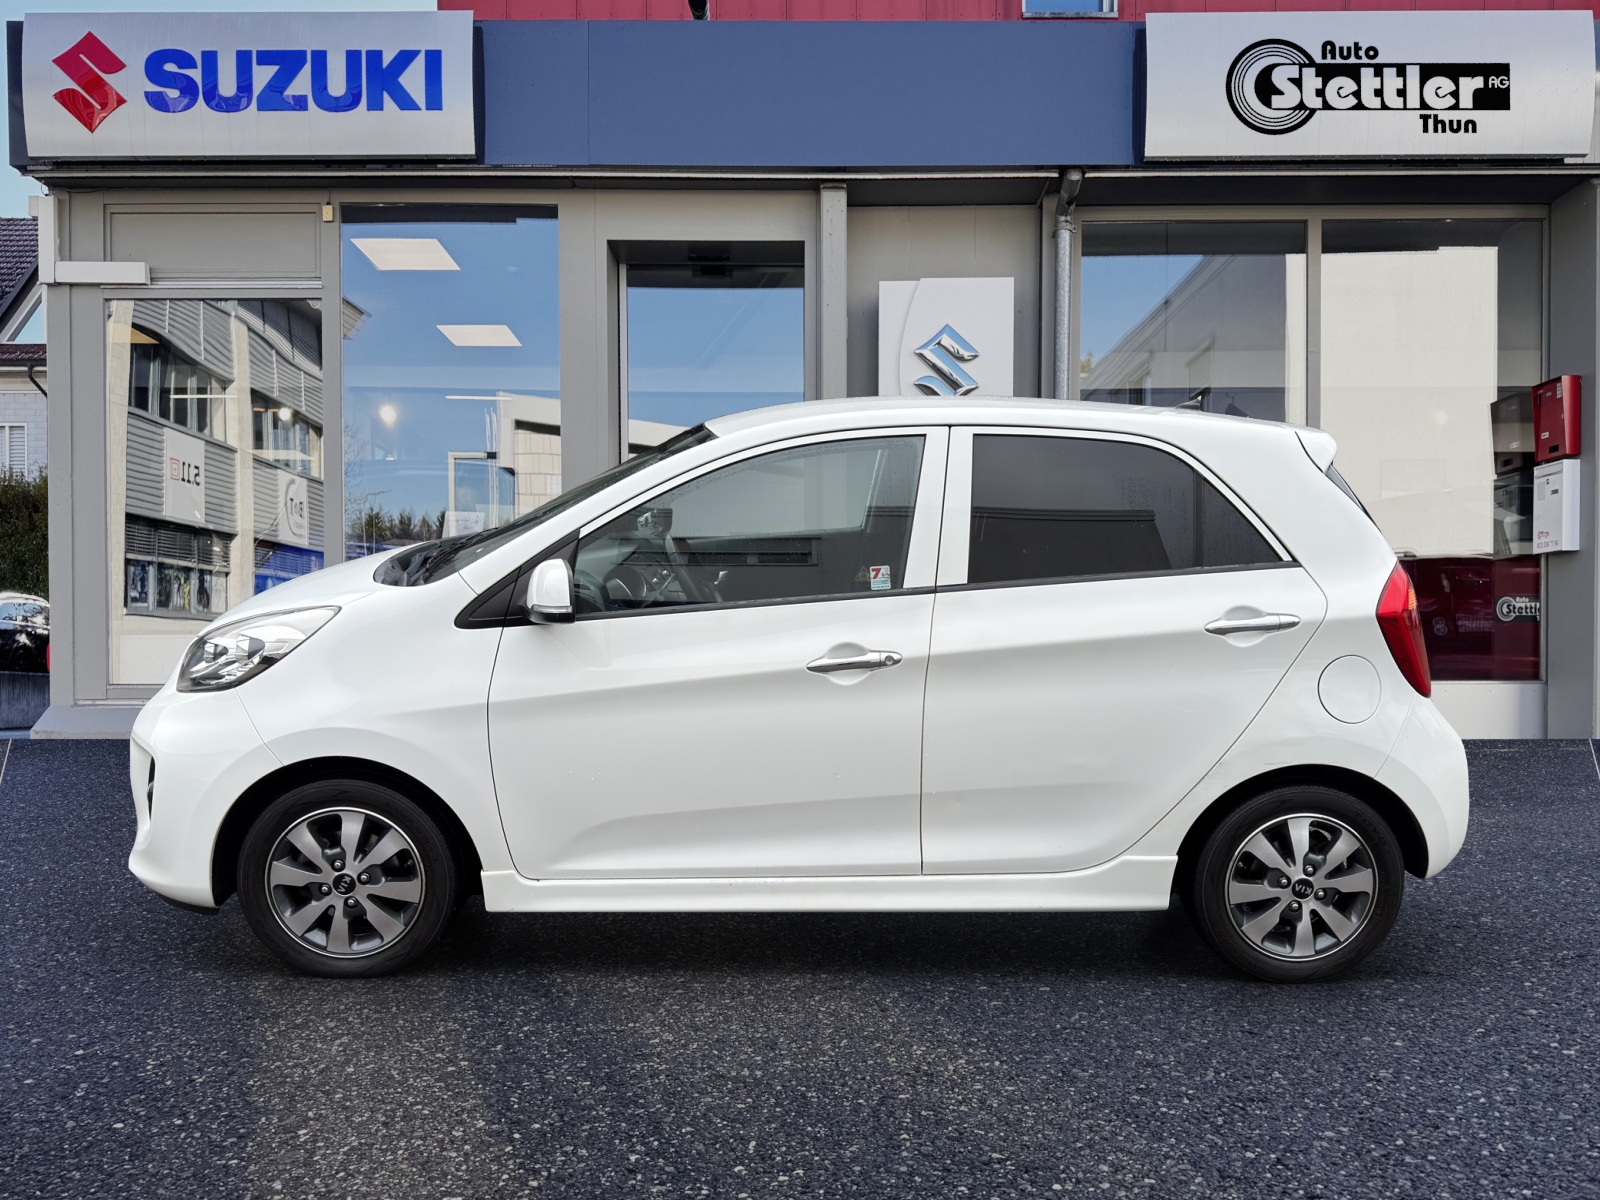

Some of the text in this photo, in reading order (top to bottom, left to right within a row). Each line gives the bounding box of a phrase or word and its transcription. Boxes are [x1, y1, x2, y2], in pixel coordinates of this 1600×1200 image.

[1321, 40, 1379, 60] Auto
[143, 48, 443, 113] SUZUKI
[1271, 65, 1509, 110] Stettler AG
[1419, 113, 1477, 134] Thun
[871, 568, 882, 579] 7
[1506, 603, 1540, 614] Stettl
[337, 875, 351, 892] KIA
[1295, 883, 1312, 895] KIA
